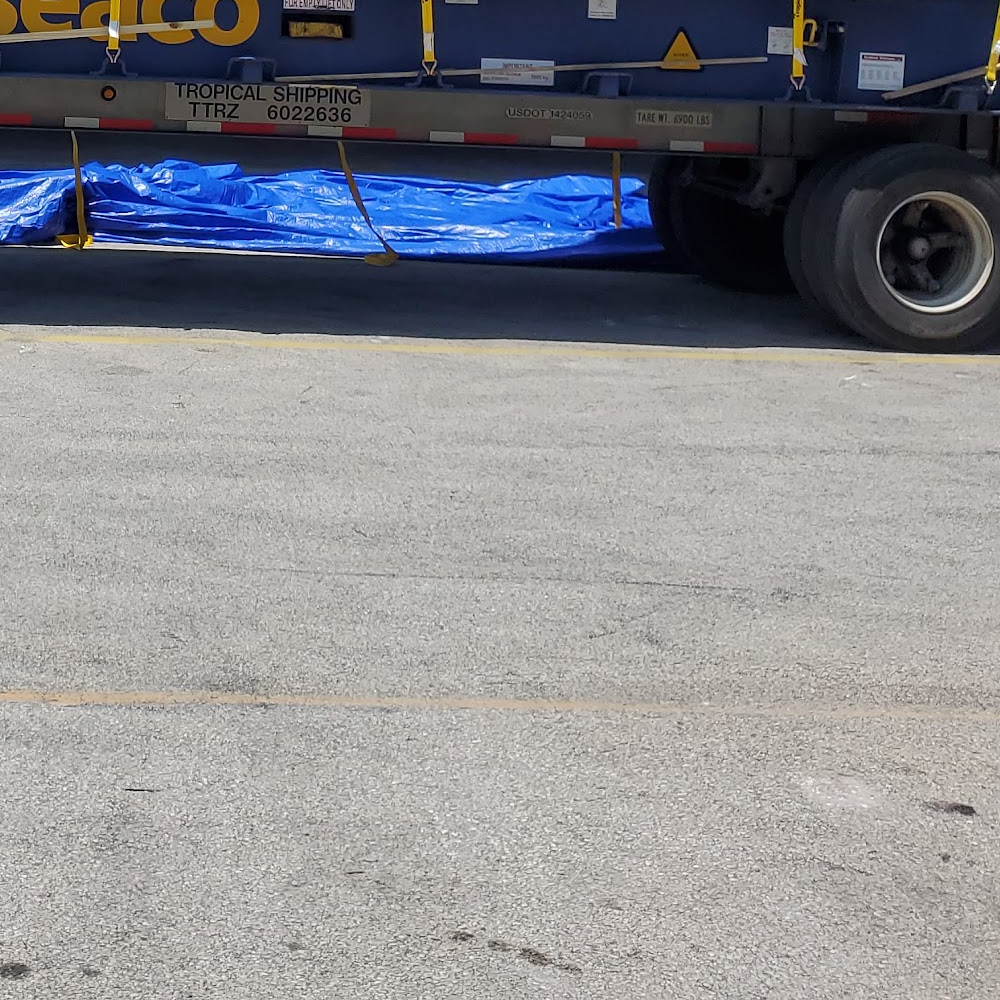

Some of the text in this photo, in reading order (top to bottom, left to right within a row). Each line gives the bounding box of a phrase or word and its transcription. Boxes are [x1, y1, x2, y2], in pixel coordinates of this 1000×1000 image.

[337, 0, 354, 10] ONLY
[174, 82, 362, 105] TROPICAL SHIPPING
[188, 101, 352, 123] TTRZ 6022636
[508, 108, 592, 120] USDOT 1424059
[637, 111, 656, 123] TARE
[673, 114, 694, 125] 6900
[696, 115, 711, 126] LBS
